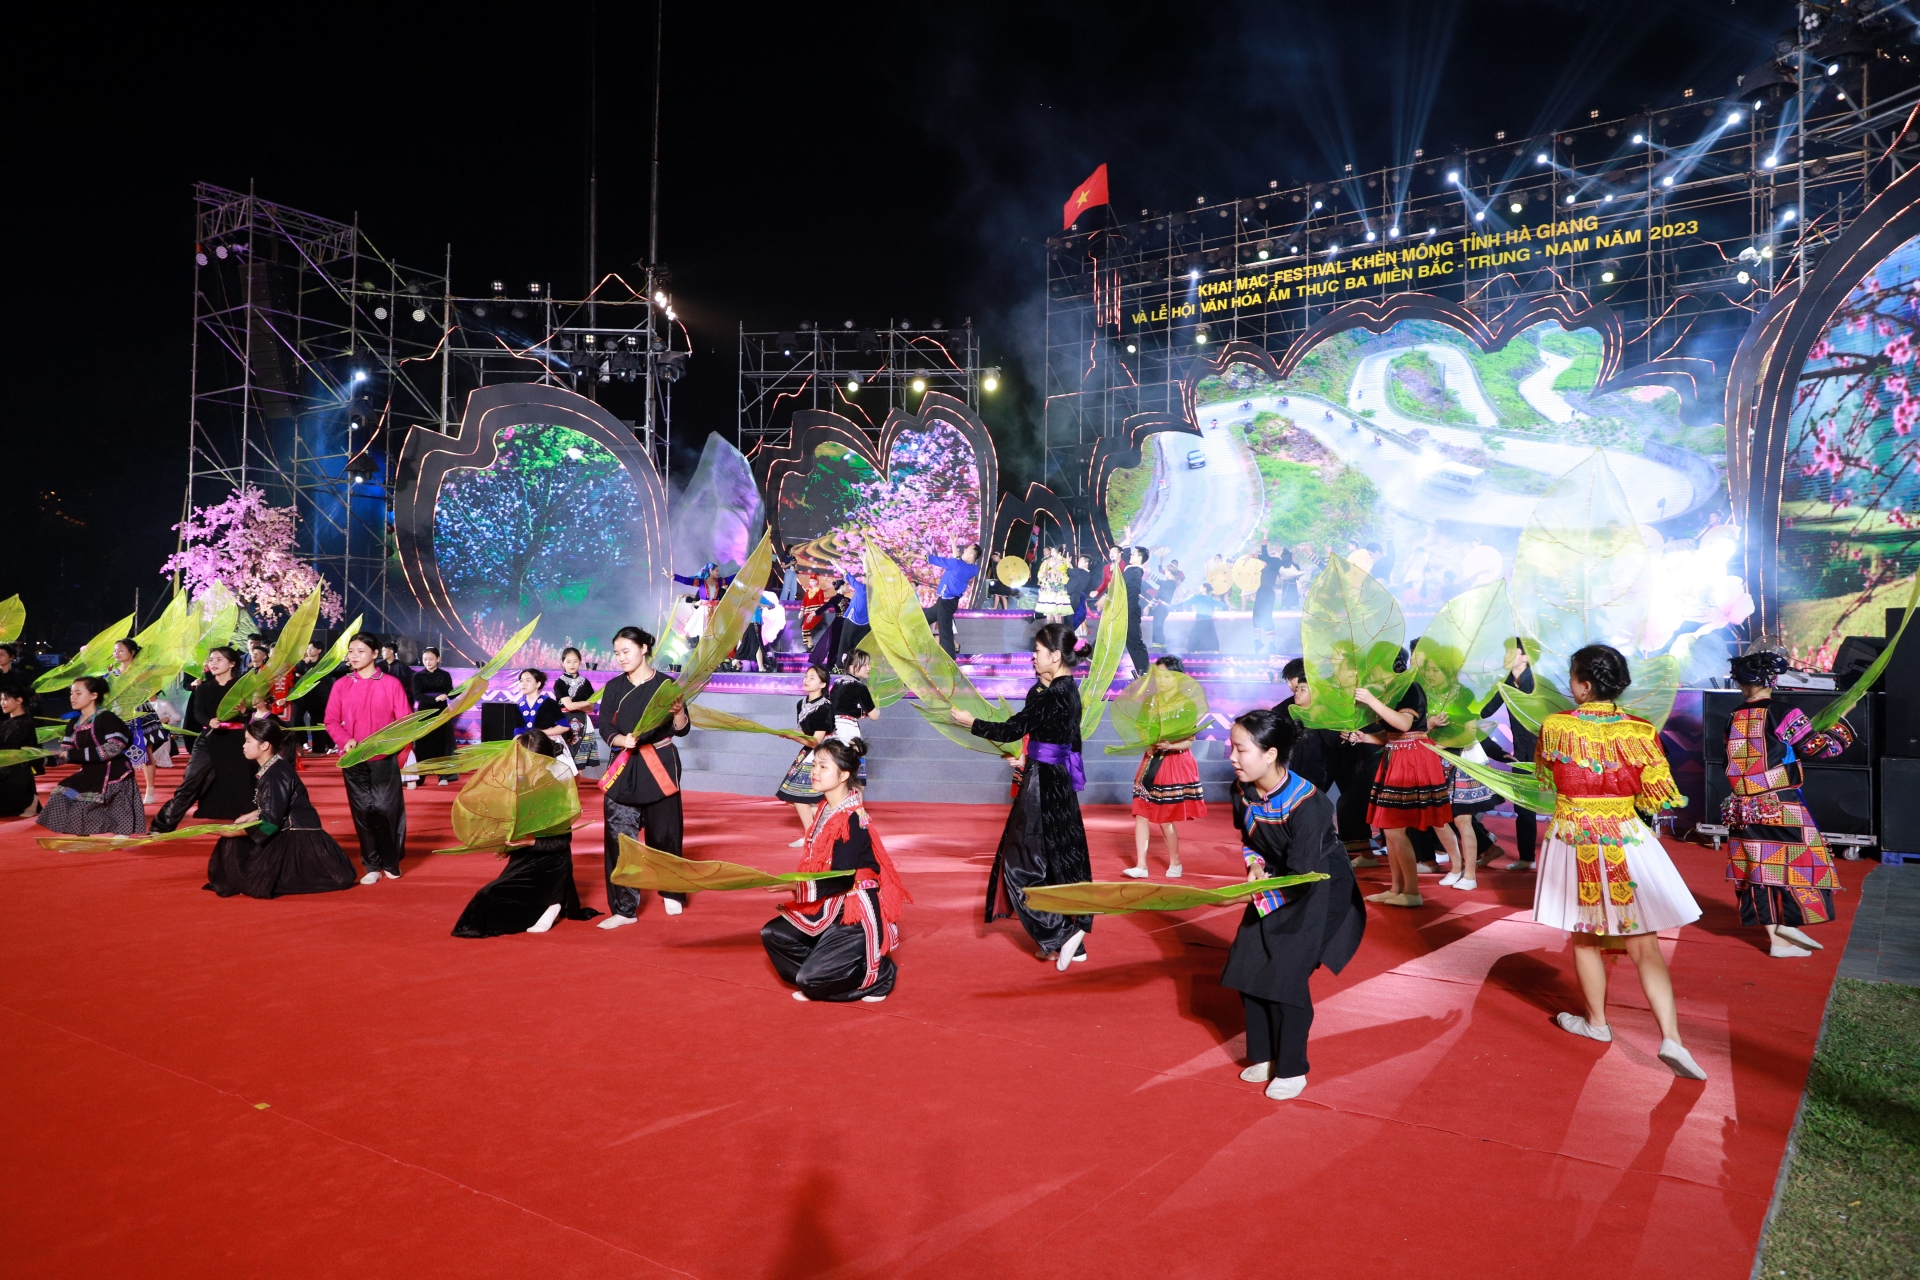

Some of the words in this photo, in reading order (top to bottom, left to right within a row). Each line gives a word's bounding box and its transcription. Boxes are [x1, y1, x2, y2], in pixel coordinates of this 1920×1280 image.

[1132, 310, 1147, 324] VÀ
[1151, 303, 1168, 321] LỄ
[1172, 303, 1195, 318] HỘI
[1200, 298, 1228, 313] VĂN
[1231, 291, 1262, 308] HÓA
[1266, 284, 1290, 302] ẨM
[1296, 280, 1339, 297] THỰC
[1345, 277, 1367, 290] BA
[1373, 265, 1413, 285] MIỀN
[1418, 256, 1454, 278] BẮC
[1468, 248, 1530, 269] TRUNG
[1545, 238, 1589, 258] NAM
[1596, 229, 1641, 250] NĂM
[1650, 220, 1698, 240] 2023
[1197, 281, 1232, 297] KHAI
[1236, 274, 1269, 291] MẠC
[1274, 261, 1346, 284] FESTIVAL
[1352, 250, 1397, 271] KHÈN
[1402, 241, 1454, 262] MÔNG
[1460, 232, 1500, 252] TỈNH
[1506, 225, 1531, 244] HÀ
[1536, 216, 1598, 239] GIANG
